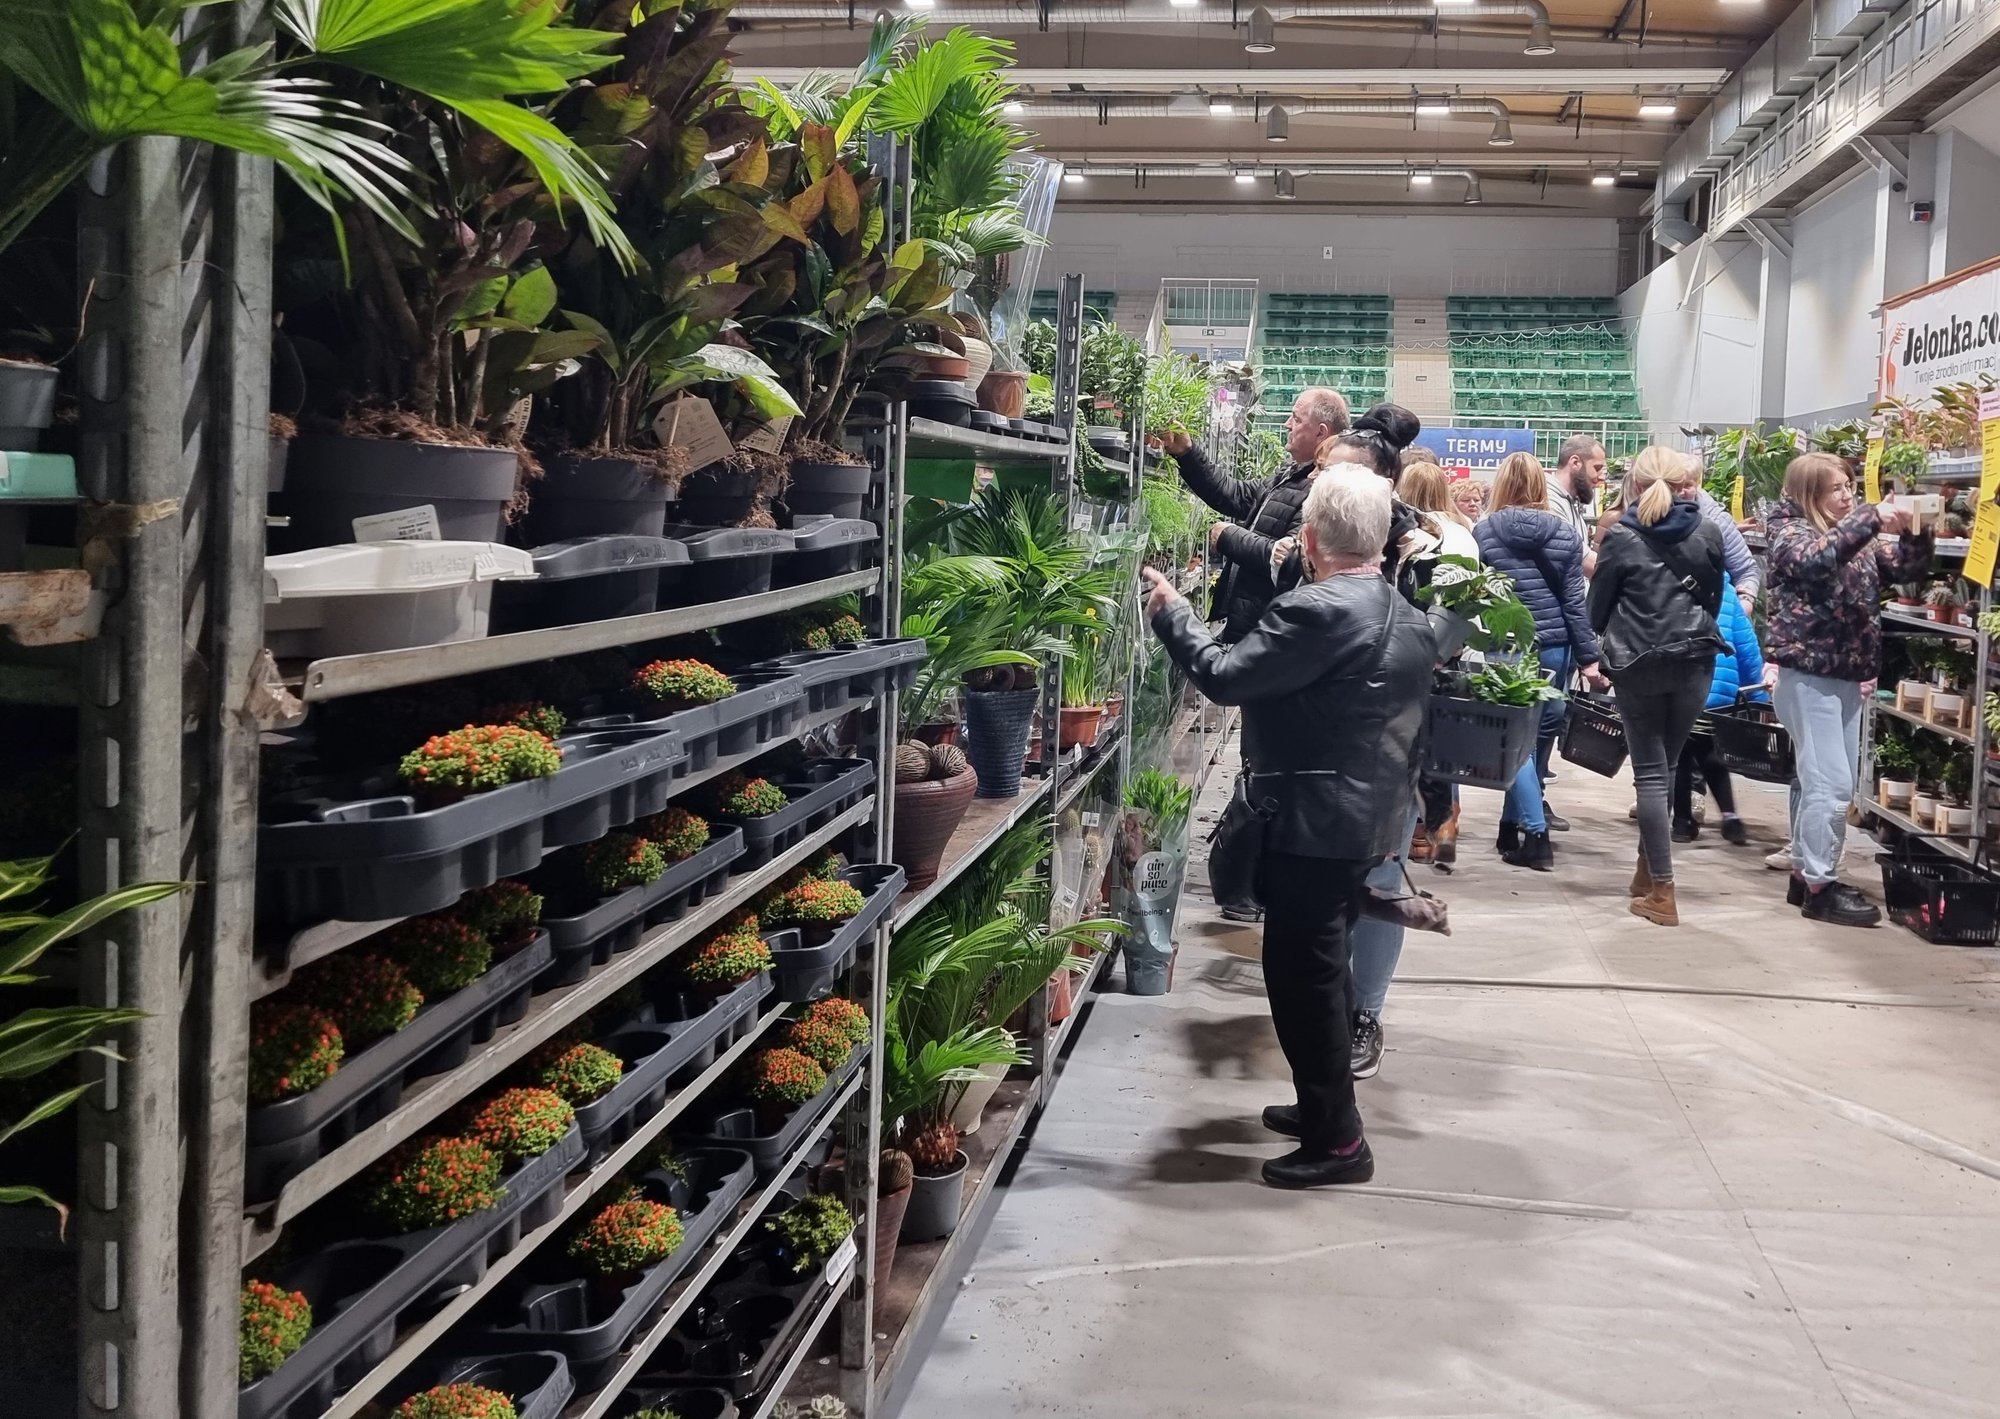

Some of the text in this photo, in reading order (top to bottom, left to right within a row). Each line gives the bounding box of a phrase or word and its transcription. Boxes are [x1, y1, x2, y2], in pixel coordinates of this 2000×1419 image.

[1903, 311, 2000, 366] Jelonka.co
[1446, 438, 1507, 453] TERMY
[1147, 858, 1164, 871] air
[1148, 871, 1160, 880] so
[1141, 880, 1167, 892] pure
